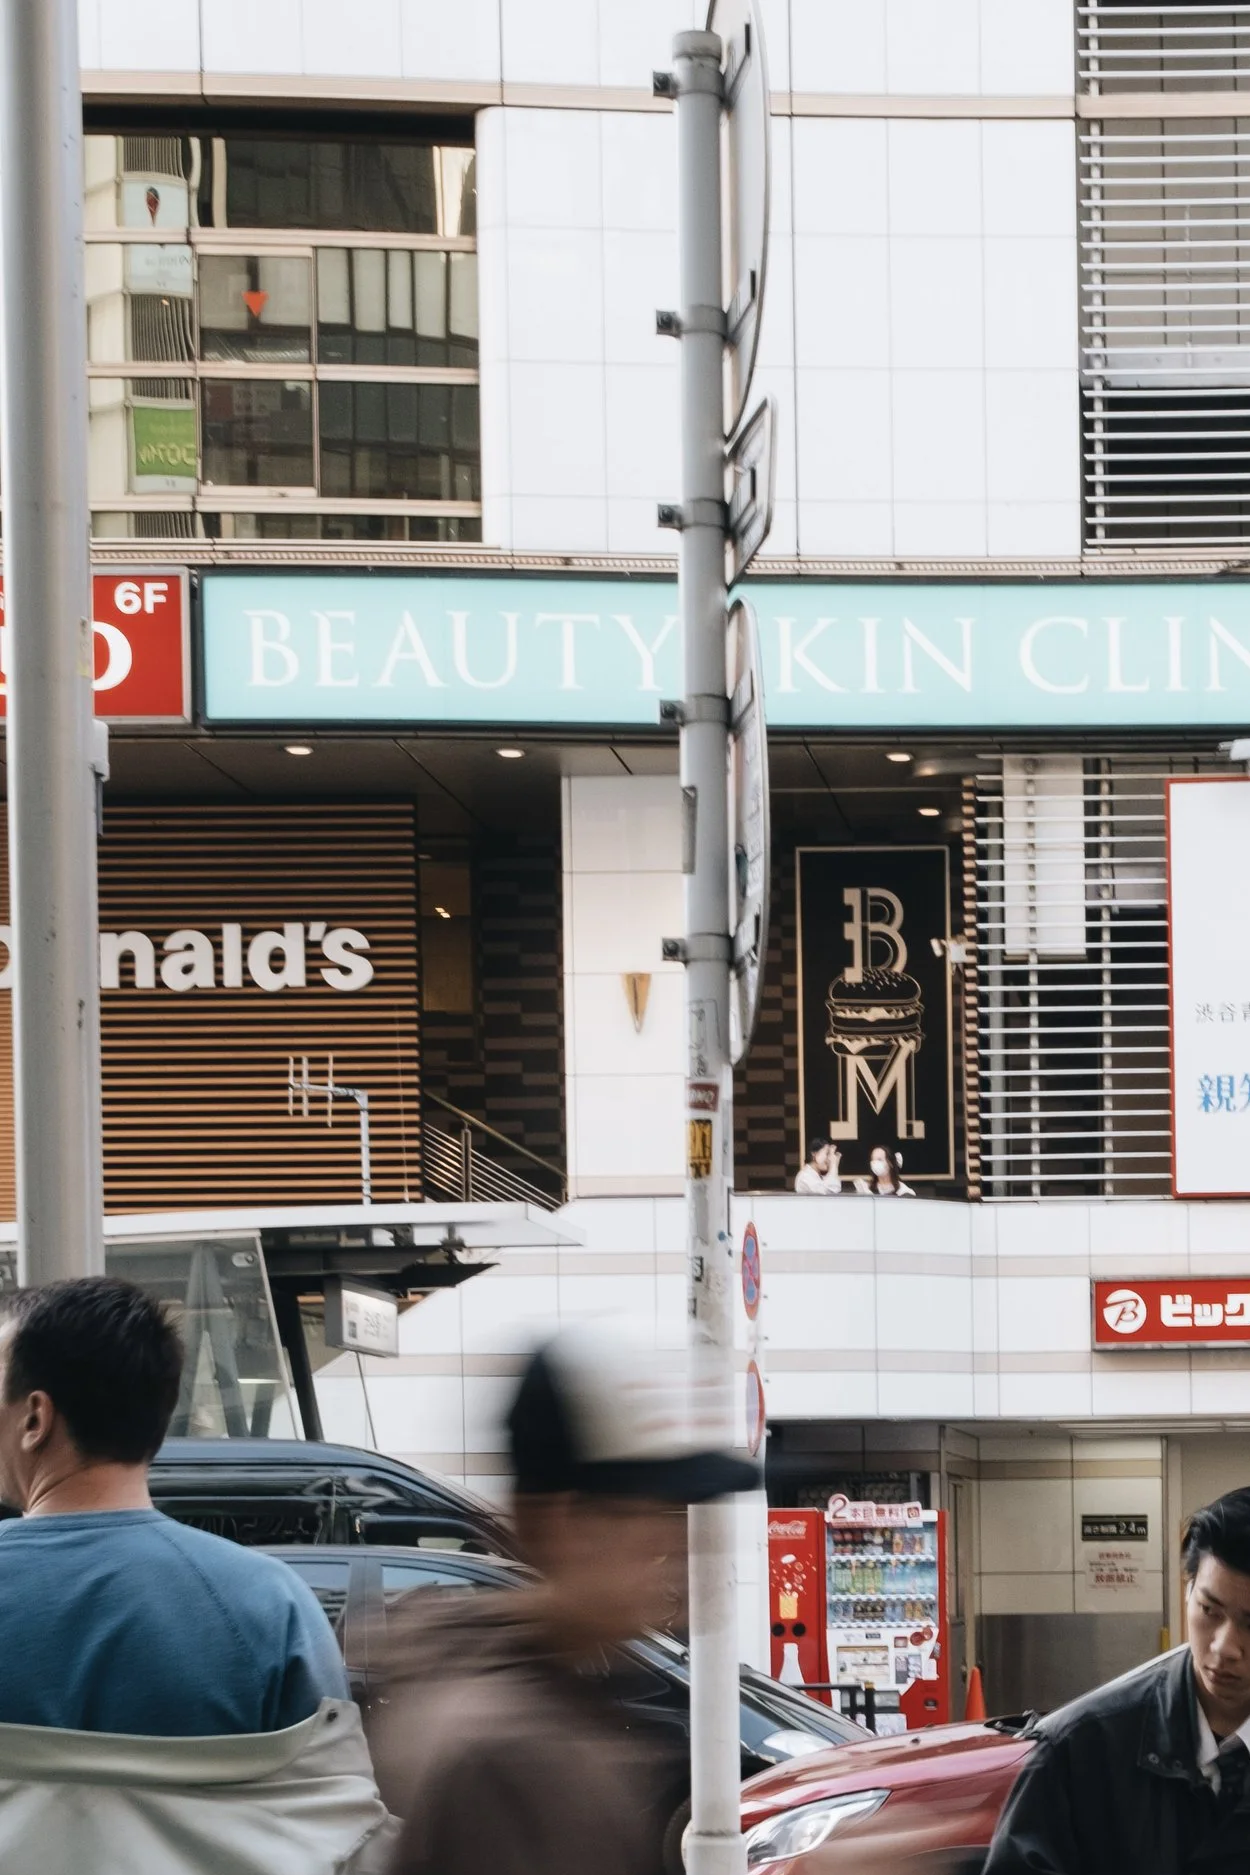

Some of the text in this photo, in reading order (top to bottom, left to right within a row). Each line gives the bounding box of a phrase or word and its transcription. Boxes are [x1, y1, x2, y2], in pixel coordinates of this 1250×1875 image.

[114, 581, 168, 615] 6F
[242, 609, 679, 691] BEAUTY
[773, 616, 978, 694] KIN
[0, 921, 374, 991] nald's
